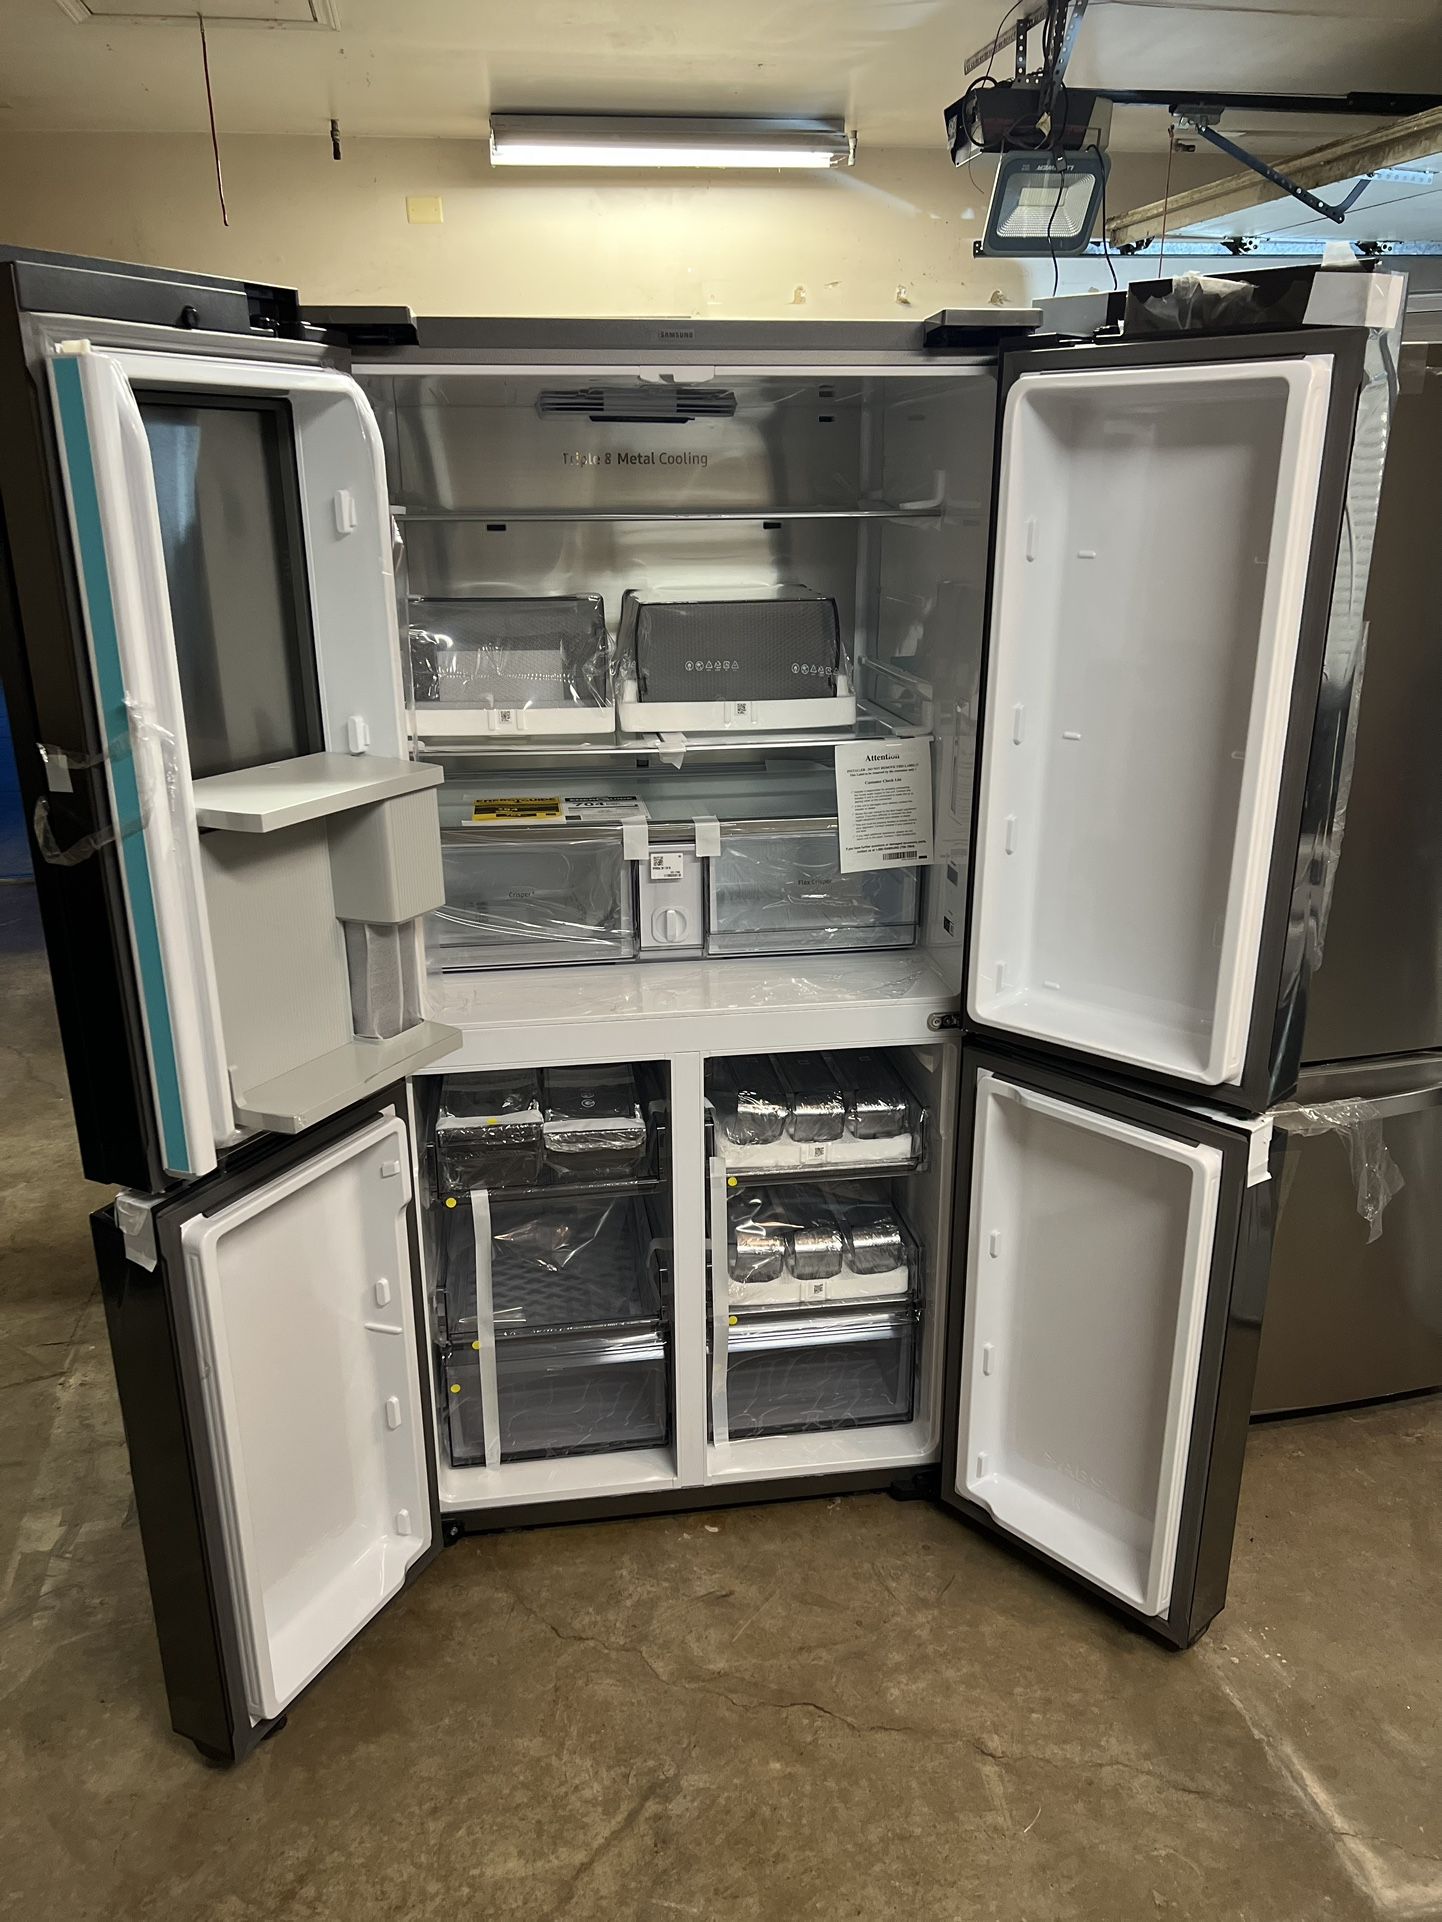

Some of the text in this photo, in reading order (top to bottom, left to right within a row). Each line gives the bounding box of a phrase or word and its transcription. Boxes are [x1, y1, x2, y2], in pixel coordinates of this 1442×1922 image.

[562, 452, 708, 467] Triple 8 Metal Cooling
[865, 753, 900, 762] Attention
